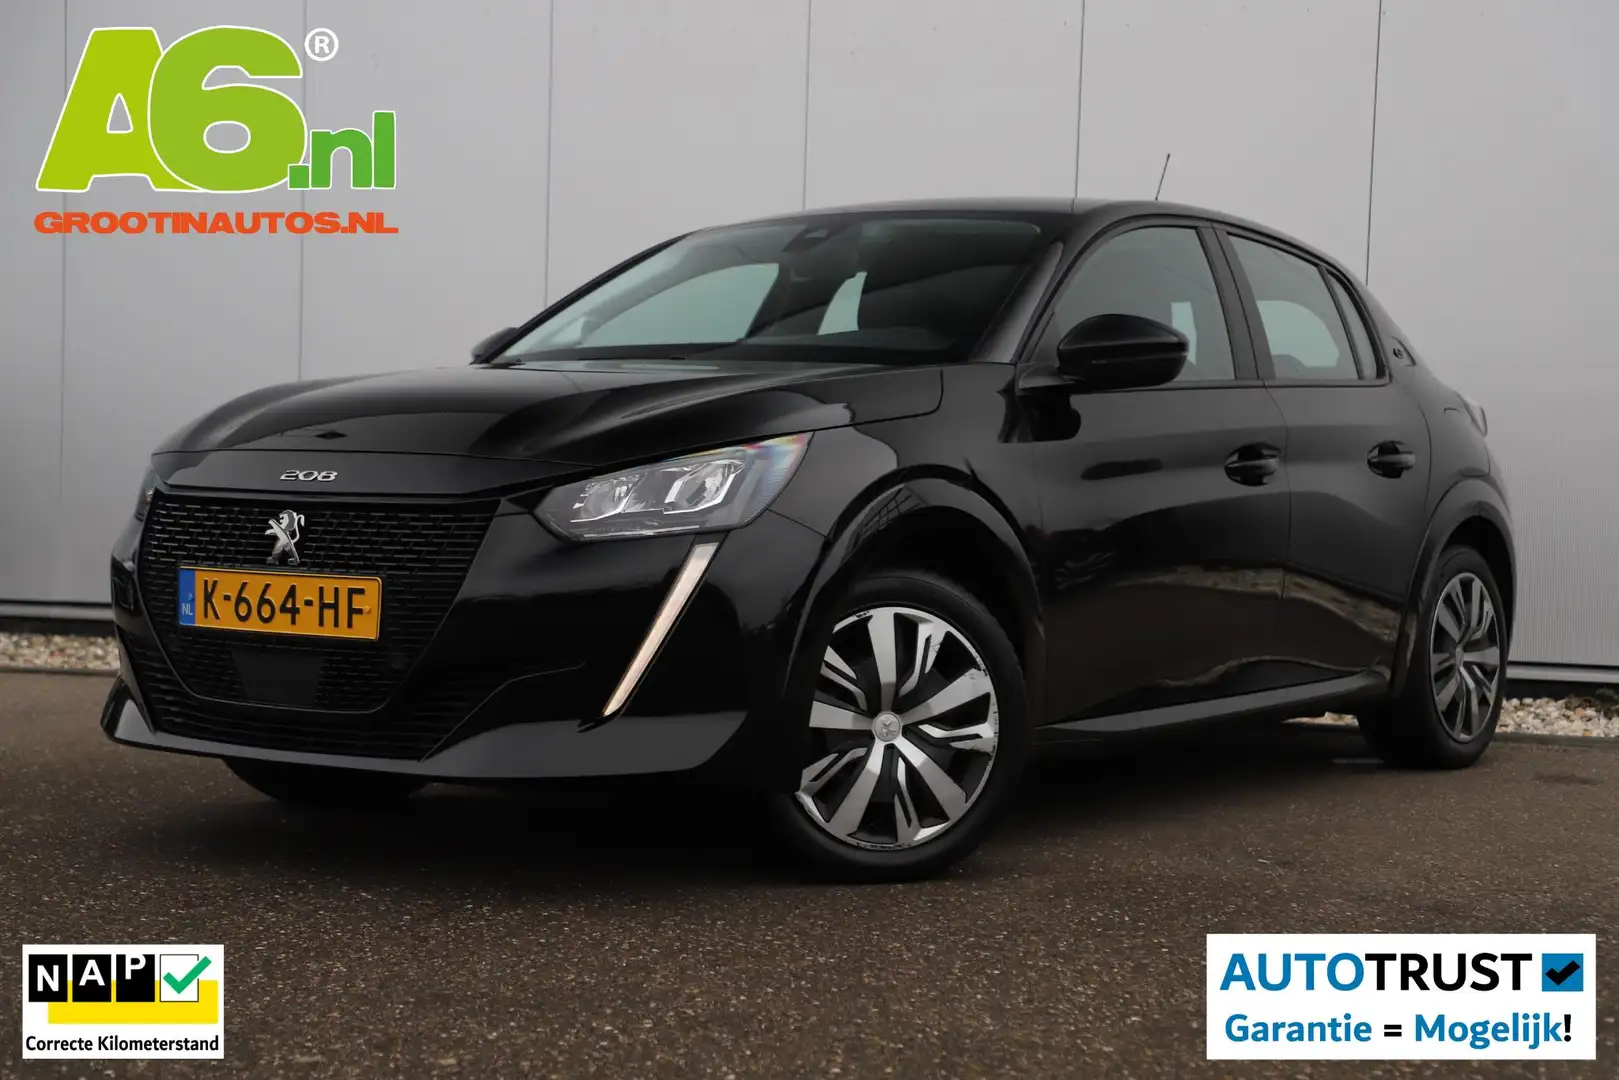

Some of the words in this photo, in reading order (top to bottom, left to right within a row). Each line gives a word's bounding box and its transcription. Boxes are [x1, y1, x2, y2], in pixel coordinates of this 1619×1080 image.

[280, 469, 338, 482] 208
[182, 603, 193, 616] NL
[203, 577, 367, 629] K-664-HF
